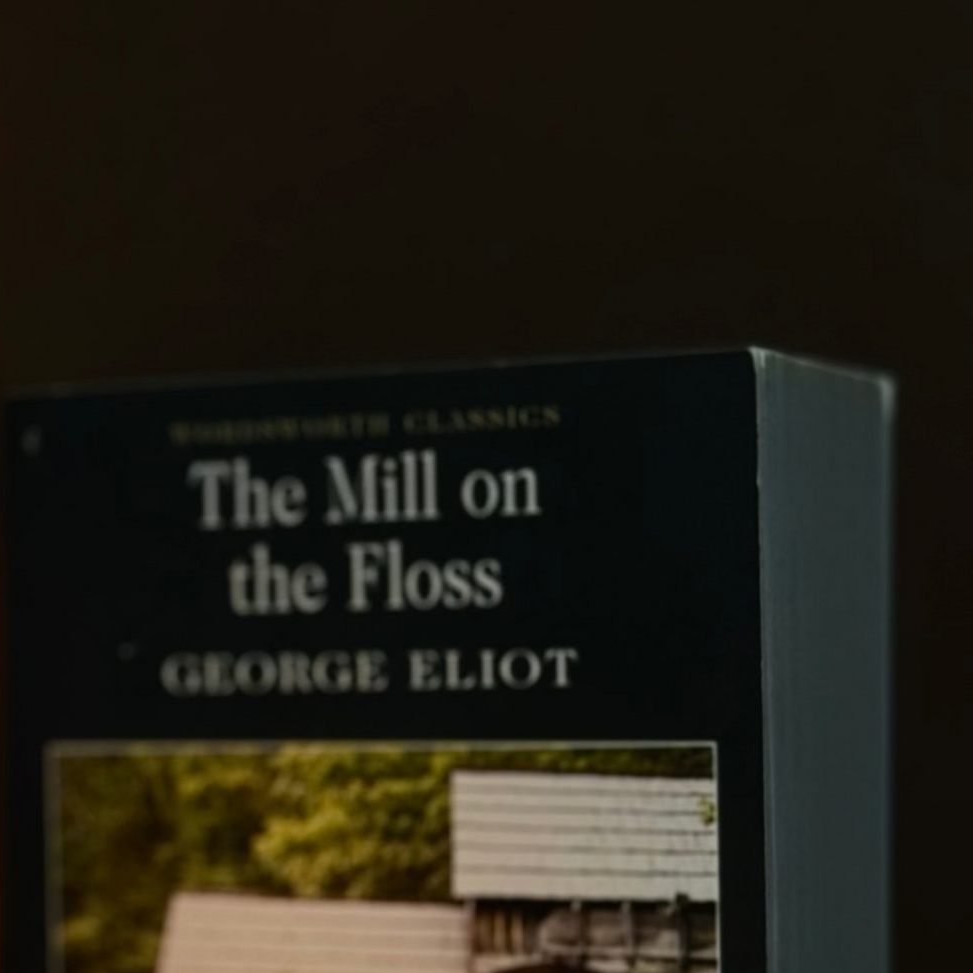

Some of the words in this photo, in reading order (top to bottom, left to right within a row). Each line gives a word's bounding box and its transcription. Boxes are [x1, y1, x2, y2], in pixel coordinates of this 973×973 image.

[403, 404, 561, 435] CLASSICS
[186, 455, 308, 531] The
[322, 448, 441, 526] Mill
[459, 464, 542, 520] on
[228, 541, 328, 617] the
[345, 537, 504, 613] Floss
[159, 649, 390, 699] GEORGE
[406, 646, 580, 692] ELIOT
